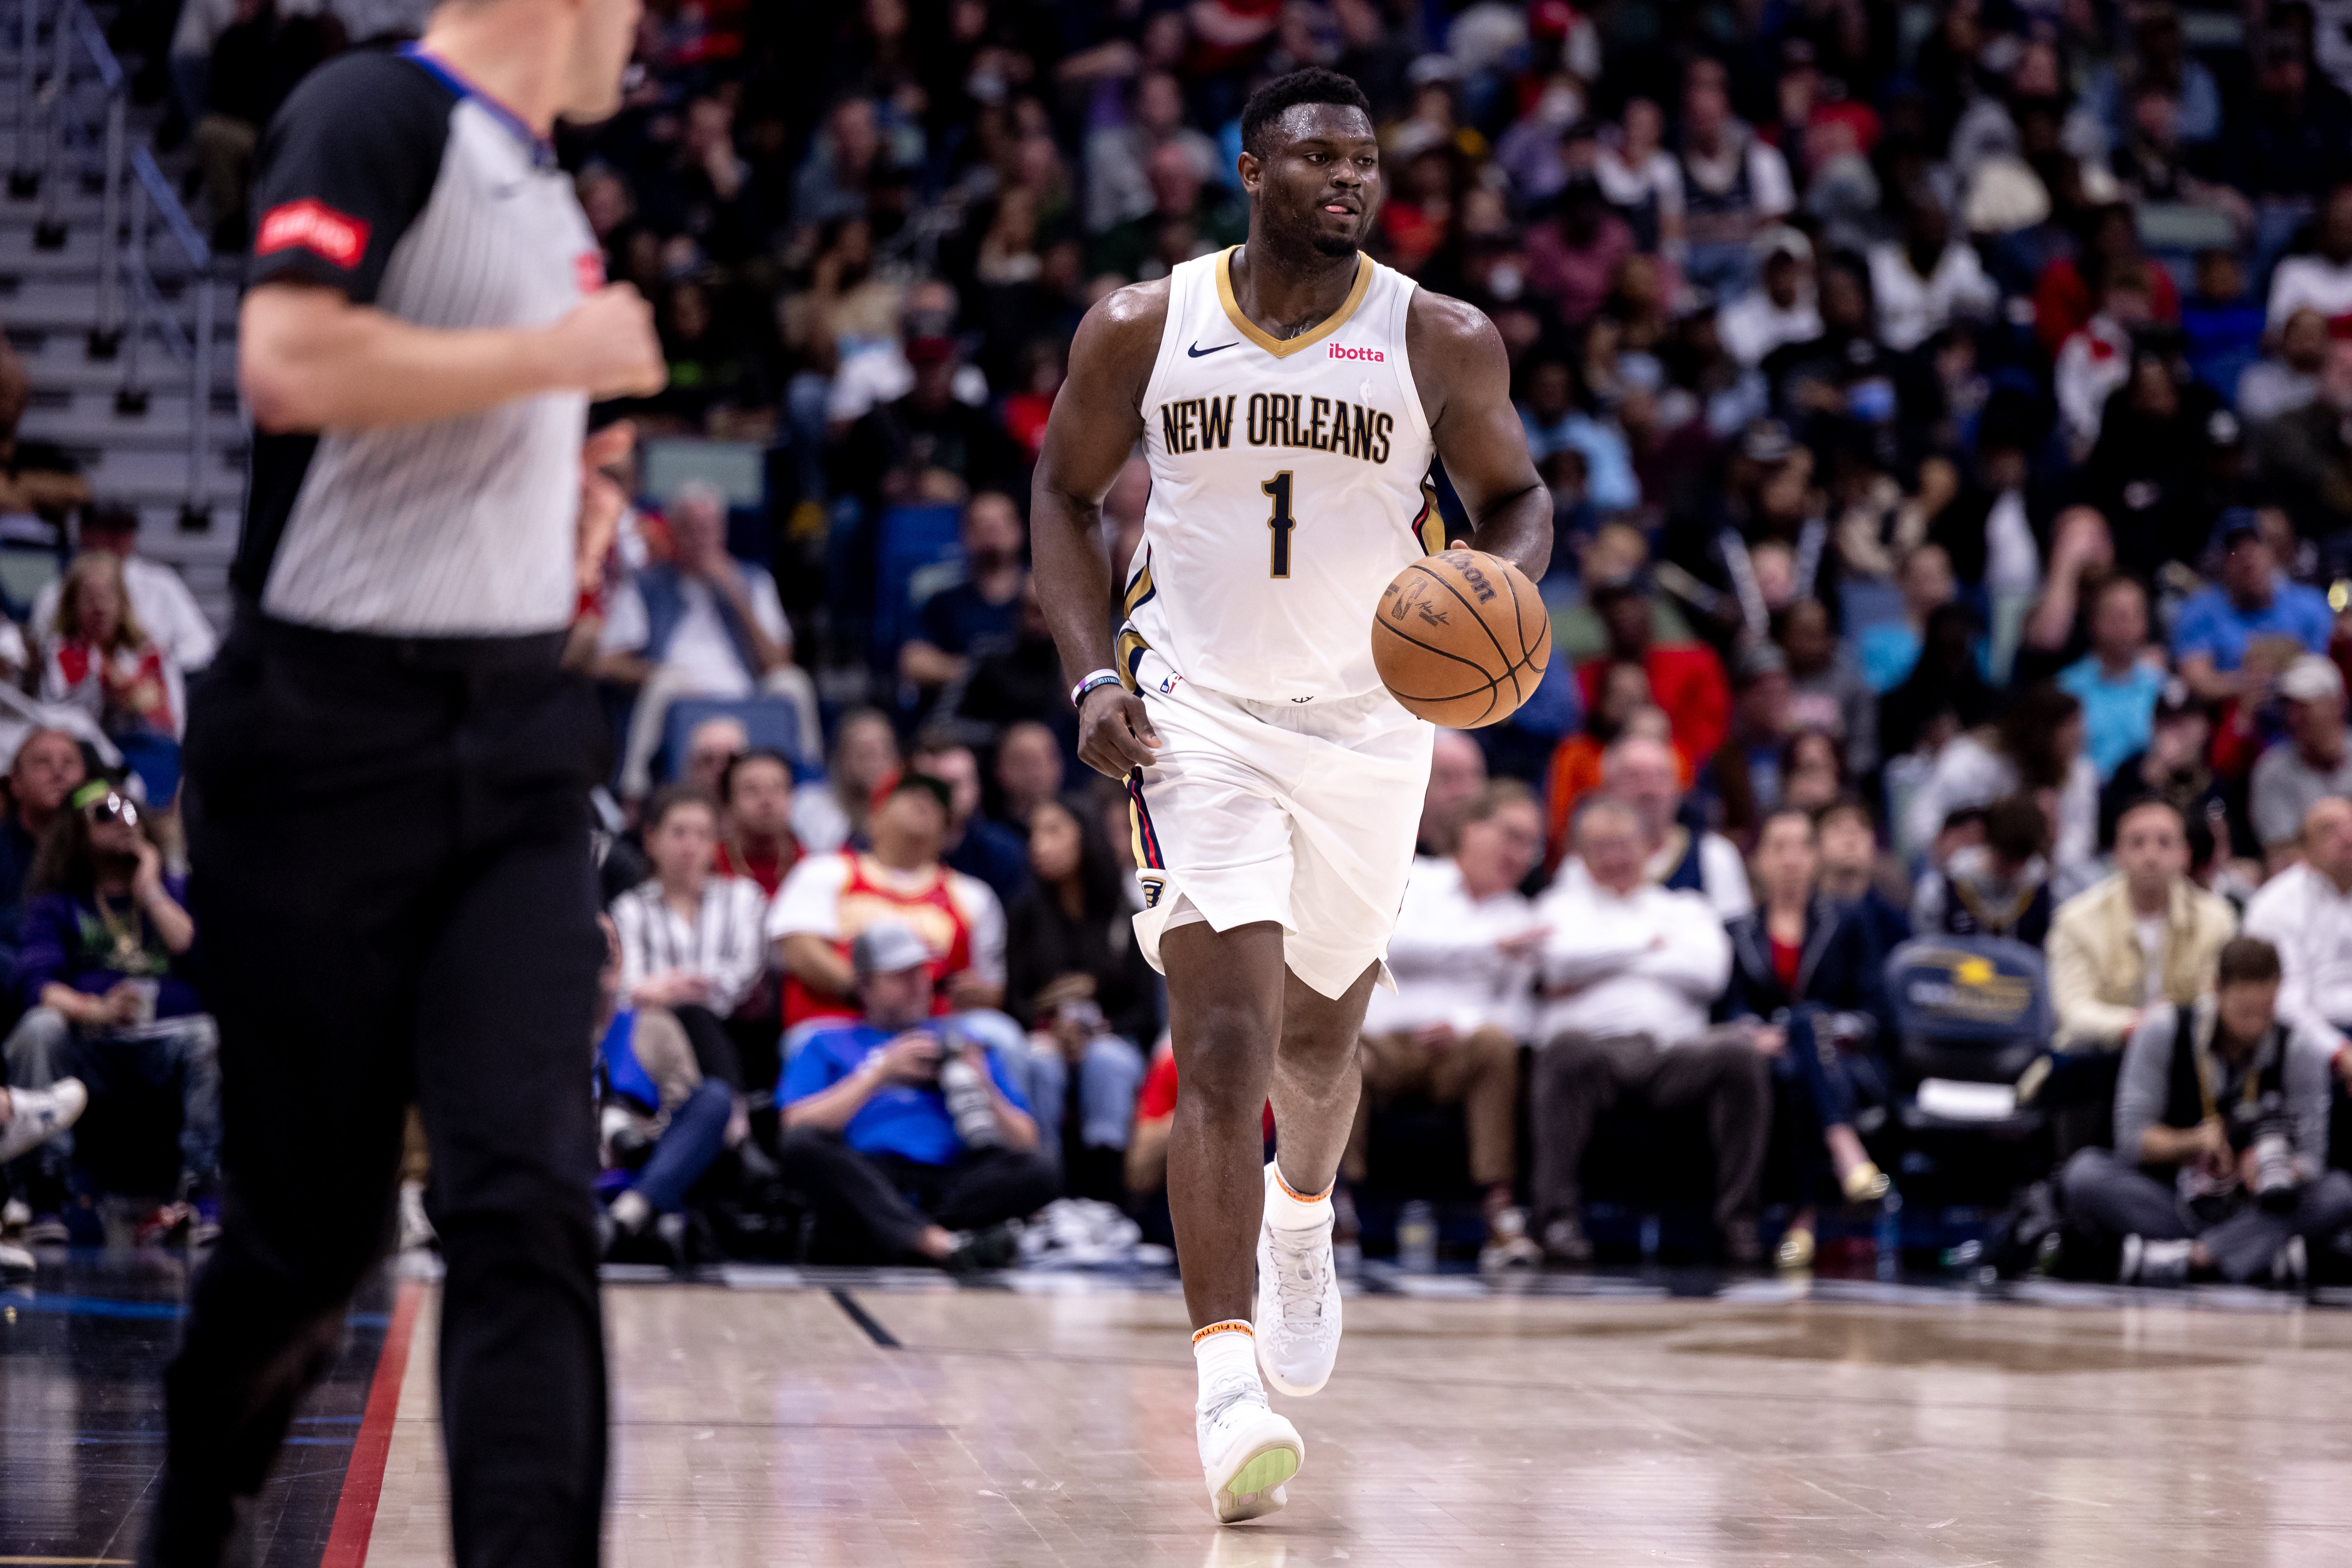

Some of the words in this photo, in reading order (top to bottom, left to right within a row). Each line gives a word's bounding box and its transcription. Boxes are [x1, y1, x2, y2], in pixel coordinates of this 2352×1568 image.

[1329, 343, 1384, 362] ibotta
[1161, 394, 1237, 455] NEW
[1246, 392, 1394, 465] ORLEANS
[1261, 470, 1297, 579] 1
